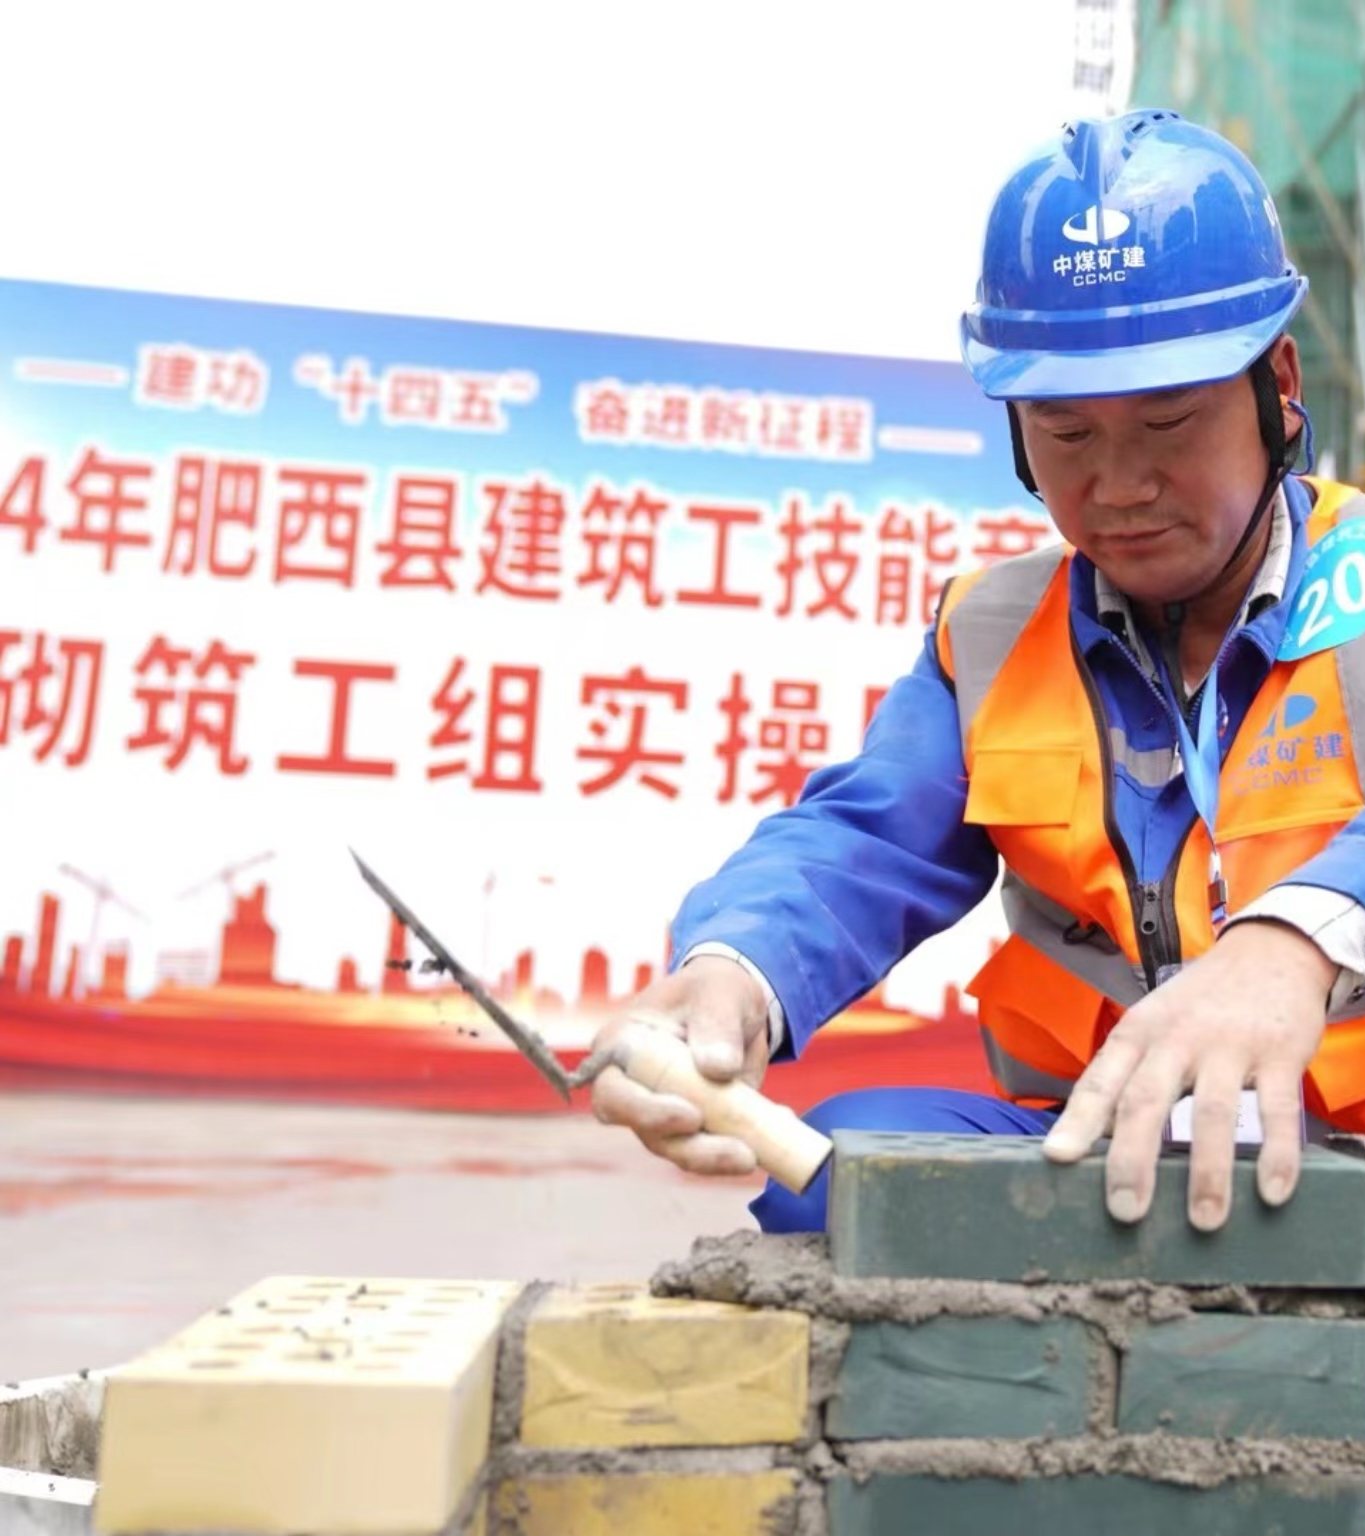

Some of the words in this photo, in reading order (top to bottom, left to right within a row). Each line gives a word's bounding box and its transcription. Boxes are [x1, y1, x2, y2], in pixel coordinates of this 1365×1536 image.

[1053, 245, 1145, 277] 中煤矿建
[1073, 270, 1126, 287] CCMC
[144, 348, 262, 405] 建功
[584, 382, 868, 453] 奋进新征程
[0, 629, 890, 807] 砌筑工组实操
